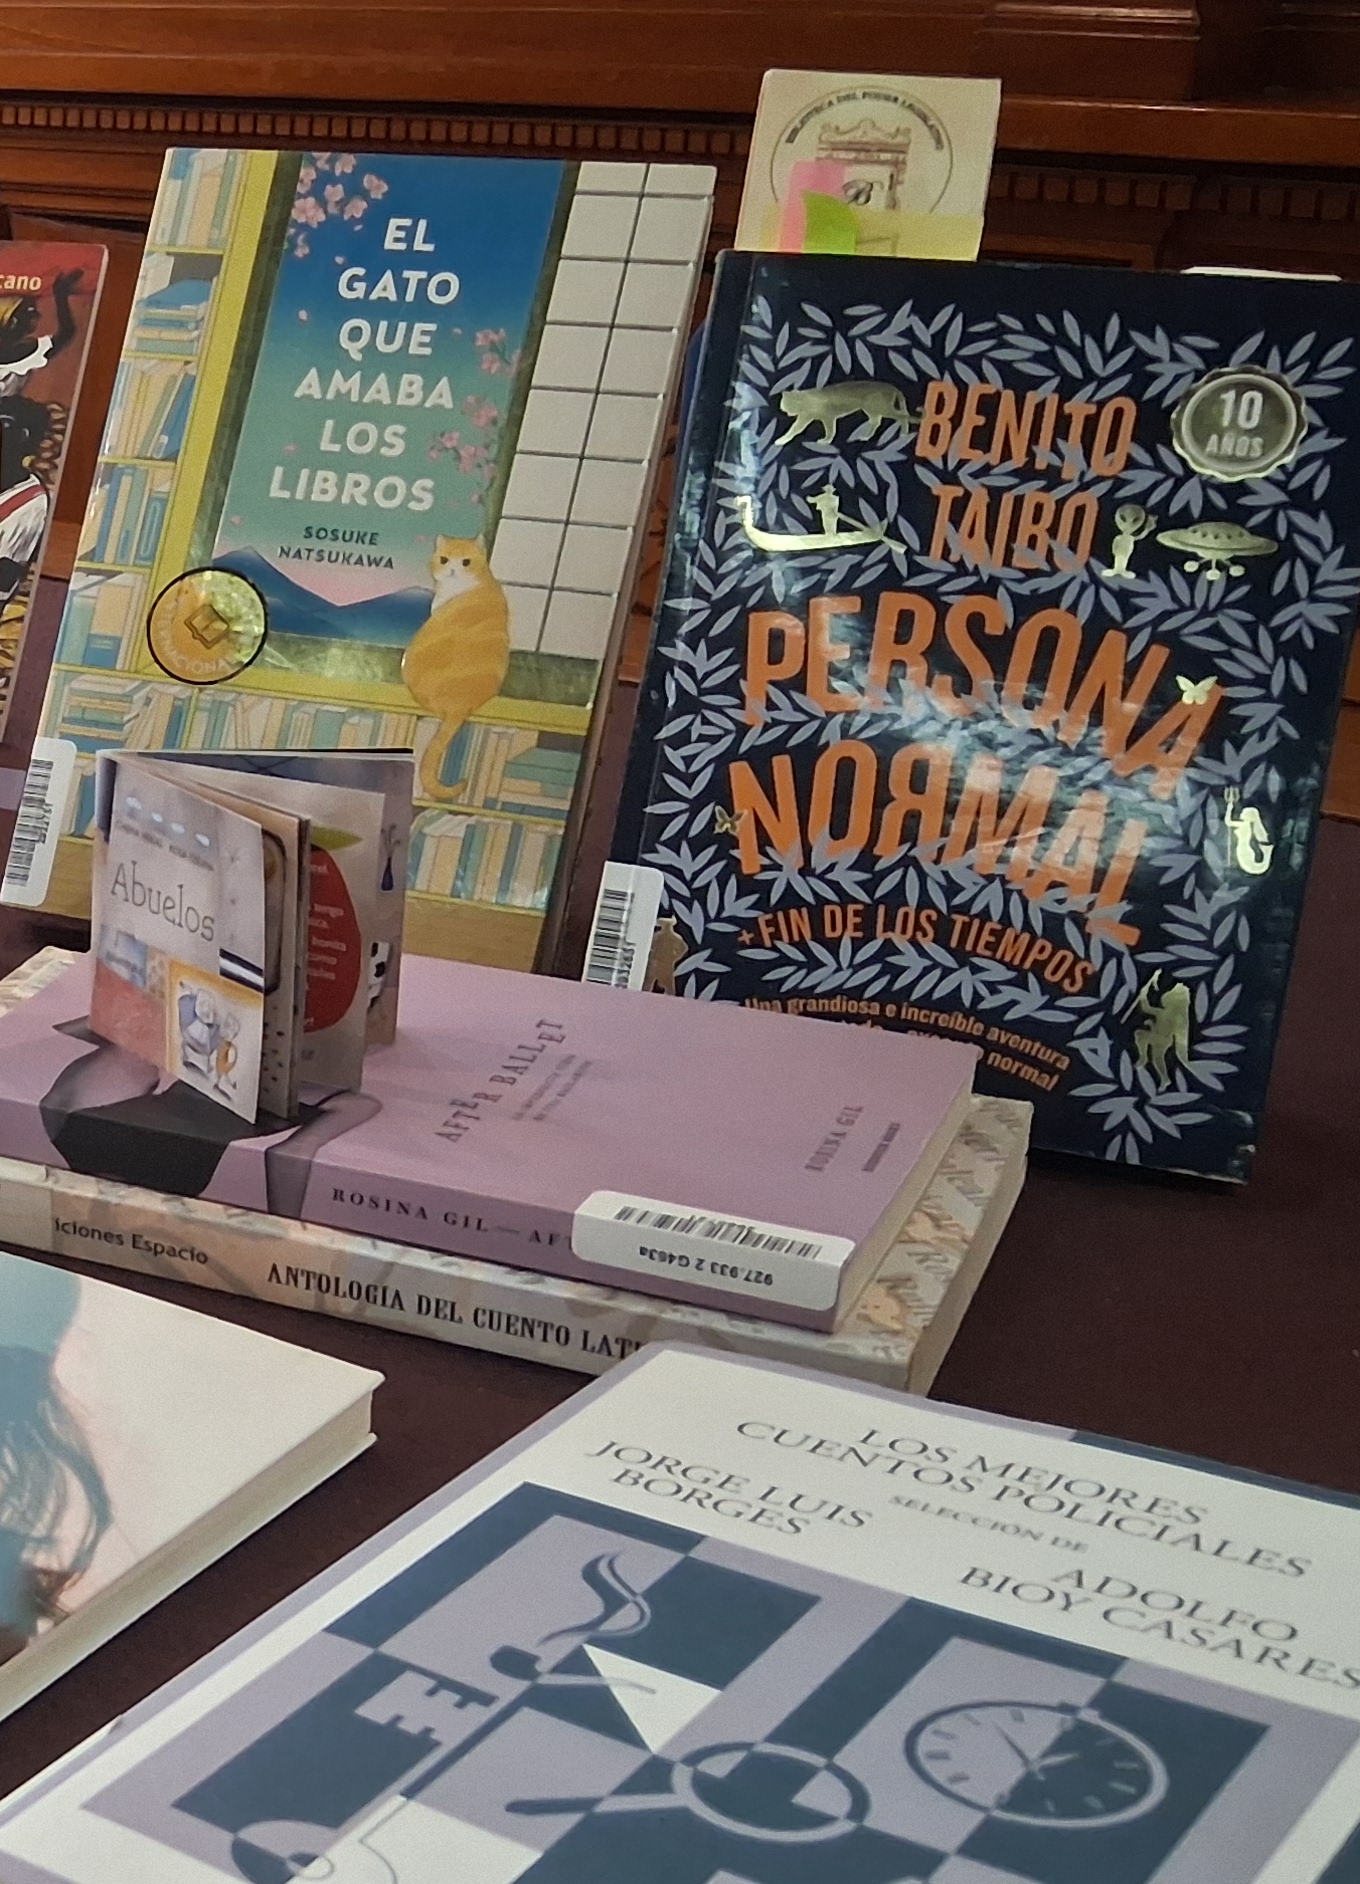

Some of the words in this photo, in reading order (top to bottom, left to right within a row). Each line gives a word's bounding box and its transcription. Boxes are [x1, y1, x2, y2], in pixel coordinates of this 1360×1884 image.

[383, 217, 435, 252] EL
[337, 266, 460, 305] GATO
[339, 319, 438, 361] QUE
[294, 366, 454, 409] AMABA
[1219, 389, 1263, 430] 10
[319, 419, 407, 457] LOS
[914, 379, 1138, 479] BENITO
[268, 466, 435, 511] LIBROS
[303, 524, 379, 547] SOSUKE
[927, 483, 1101, 573] TAIBO
[278, 545, 395, 571] NATSUKAWA
[743, 591, 1225, 800] PERSONA
[111, 860, 215, 942] Abuelos
[823, 903, 864, 939] DE
[874, 905, 938, 945] LOS
[950, 913, 1097, 995] TIEMPOS
[489, 1019, 566, 1087] BALLET
[787, 995, 881, 1017] grandiosa
[885, 1004, 897, 1018] e
[901, 1003, 985, 1036] increíble
[986, 1027, 1070, 1071] aventura
[987, 1050, 1060, 1092] normal
[434, 1092, 503, 1143] AFTER
[332, 1187, 429, 1221] ROSINA
[443, 1210, 489, 1236] GIL
[132, 1234, 209, 1266] Espacio
[266, 1261, 407, 1313] ANTOLOGÍA
[416, 1292, 464, 1327] DEL
[472, 1303, 571, 1349] CUENTO
[586, 1441, 751, 1494] JORGE
[758, 1484, 873, 1531] LUIS
[610, 1468, 809, 1538] BORGES
[734, 1419, 984, 1495] CUENTOS
[994, 1481, 1314, 1579] POLICIALES
[858, 1428, 957, 1464] LOS
[968, 1453, 1208, 1526] MEJORES
[1052, 1535, 1091, 1556] DE
[959, 1565, 1093, 1615] BIOY
[1102, 1607, 1360, 1691] CASARES
[1052, 1567, 1299, 1645] ADOLFO
